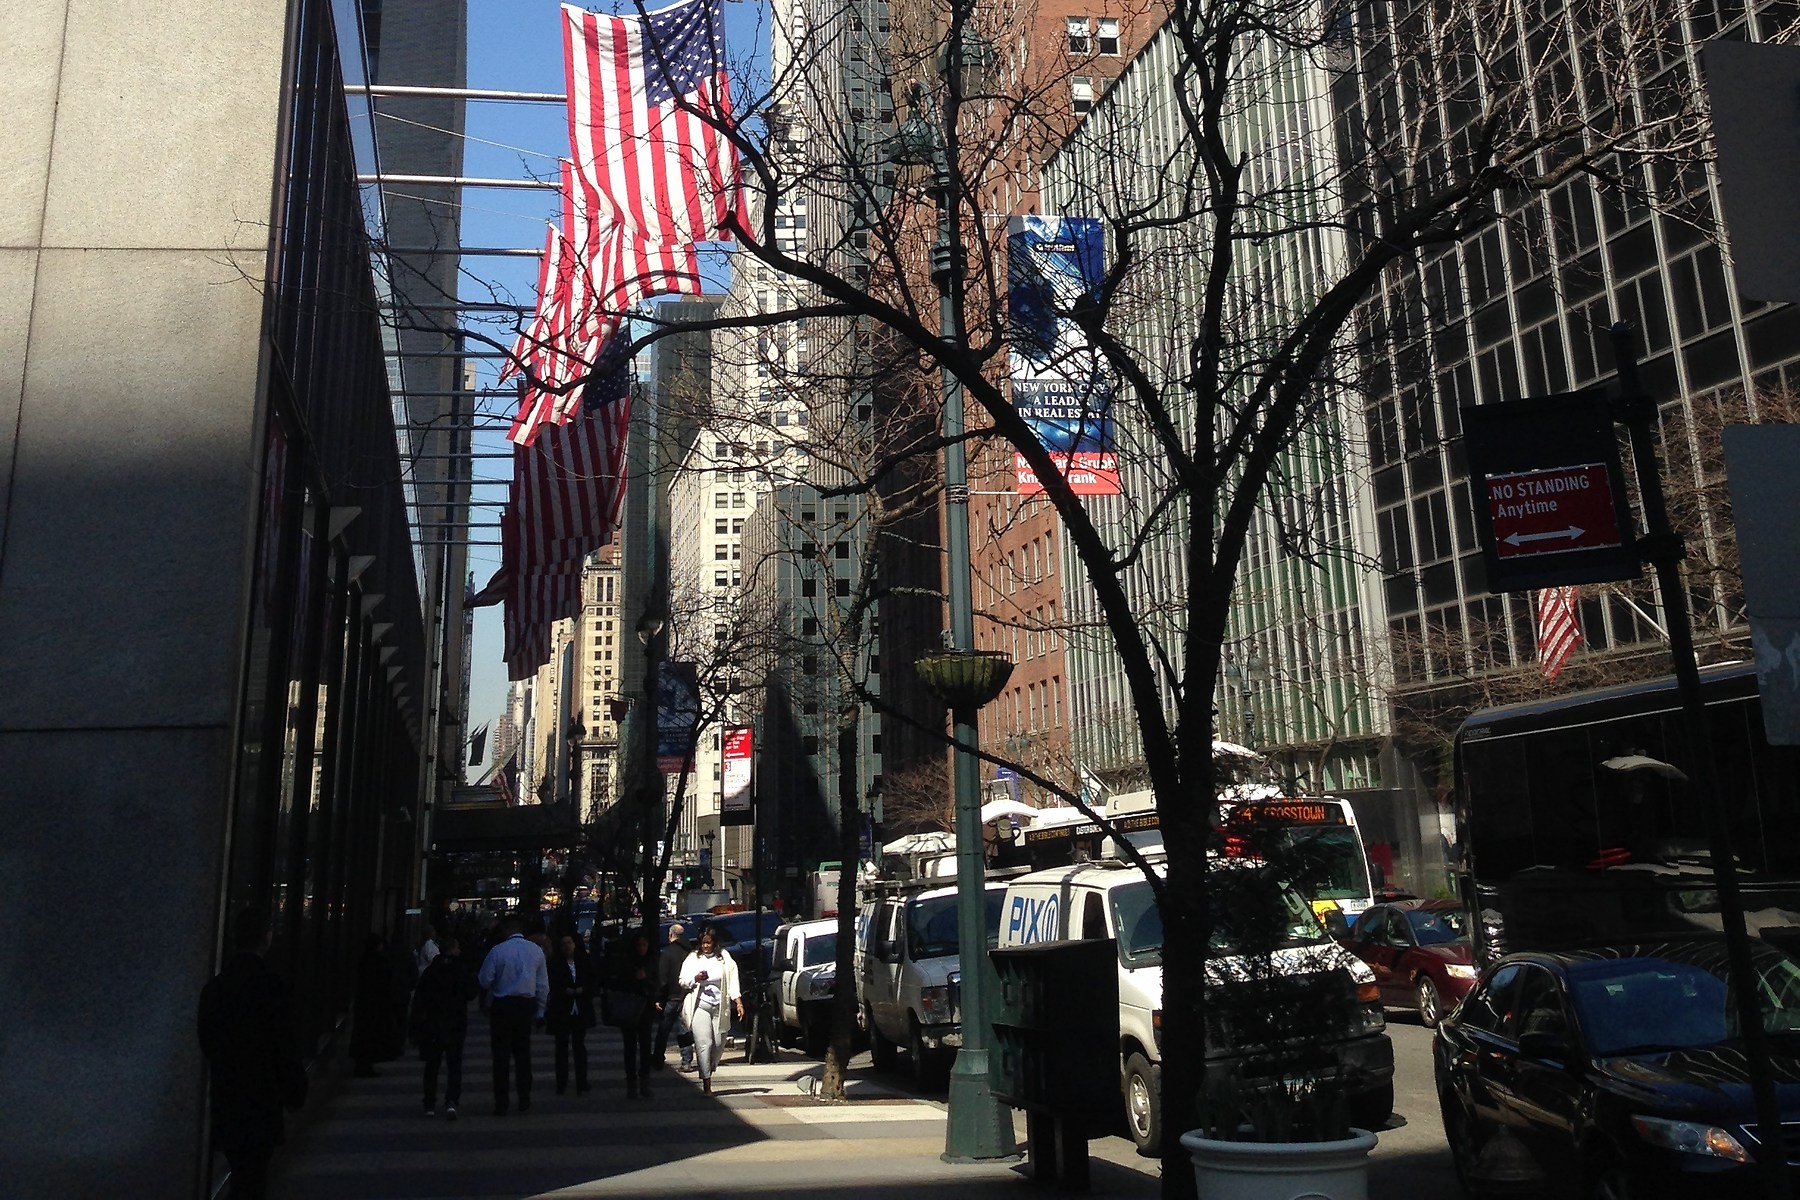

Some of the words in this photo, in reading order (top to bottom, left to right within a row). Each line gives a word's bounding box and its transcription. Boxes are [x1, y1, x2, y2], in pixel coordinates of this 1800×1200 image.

[1014, 383, 1039, 393] NEW
[1034, 397, 1041, 405] A
[1045, 396, 1091, 406] LEADE
[1018, 407, 1032, 418] IN
[1035, 408, 1065, 418] REAL
[1062, 471, 1097, 484] rank
[1493, 485, 1514, 500] NO
[1517, 474, 1590, 497] STANDING
[1497, 499, 1558, 519] Anytime
